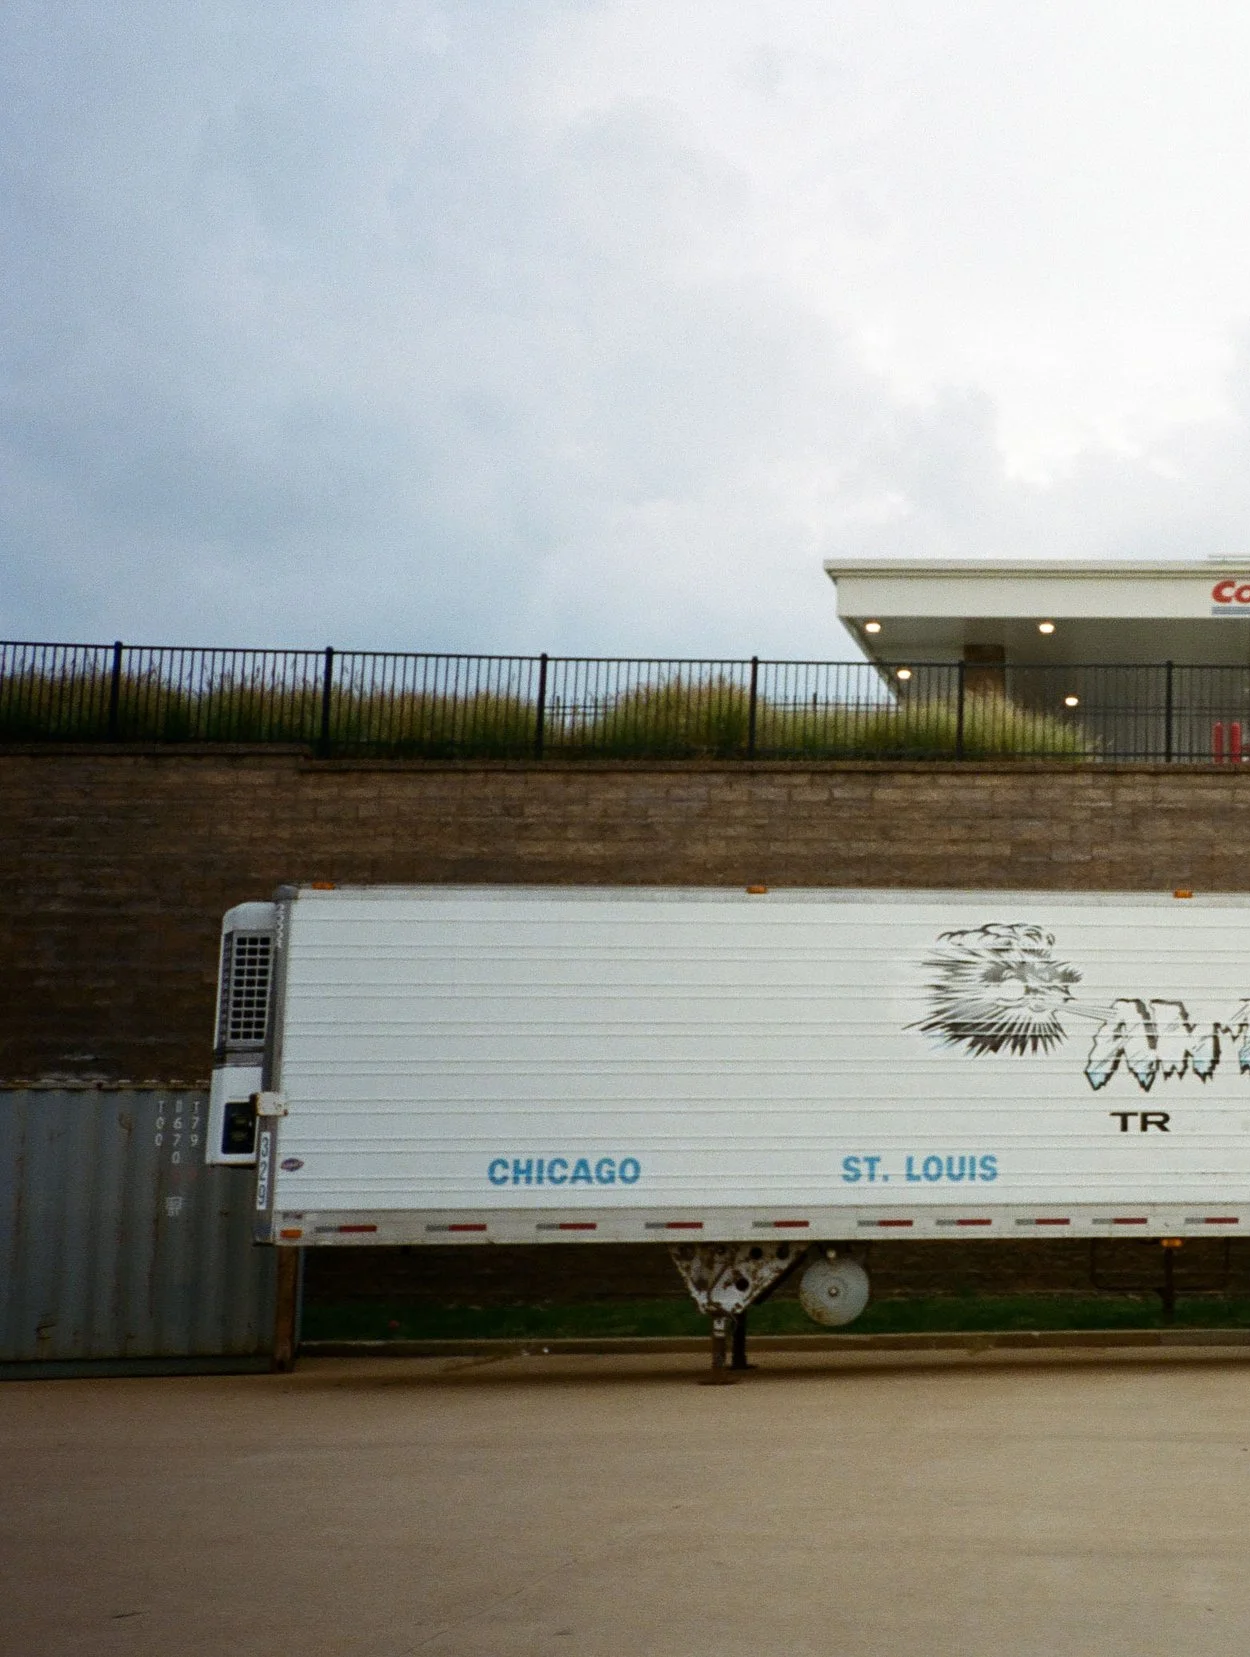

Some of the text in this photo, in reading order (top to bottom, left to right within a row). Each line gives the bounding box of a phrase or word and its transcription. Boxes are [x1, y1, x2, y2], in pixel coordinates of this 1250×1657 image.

[488, 1157, 641, 1185] CHICAGO
[841, 1154, 998, 1182] ST. LOUIS
